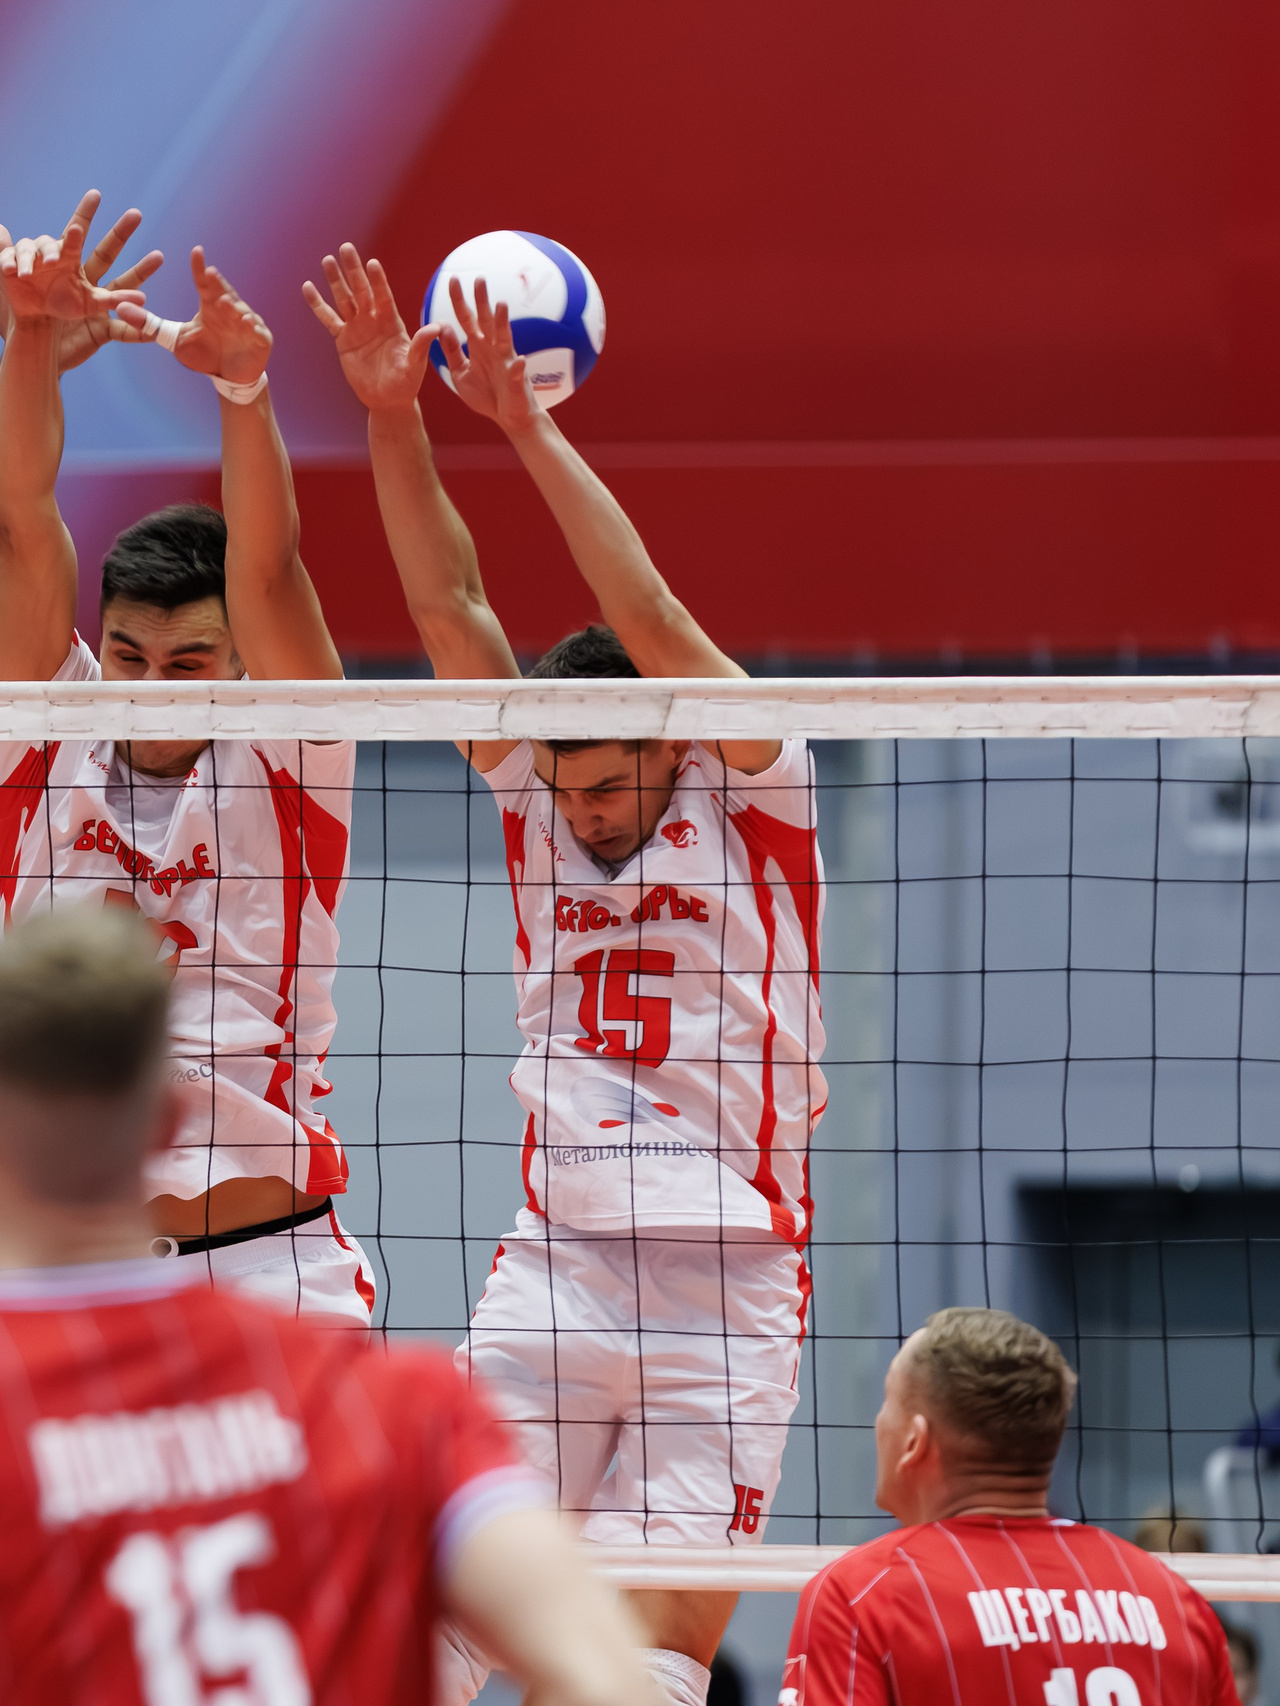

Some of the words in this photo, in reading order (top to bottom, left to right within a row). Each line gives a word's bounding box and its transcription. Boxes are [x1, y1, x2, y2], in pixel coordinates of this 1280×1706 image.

[574, 948, 675, 1069] 15
[729, 1484, 764, 1534] 15
[105, 1512, 312, 1706] 15
[968, 1587, 1167, 1651] ЩЕРБАКОВ
